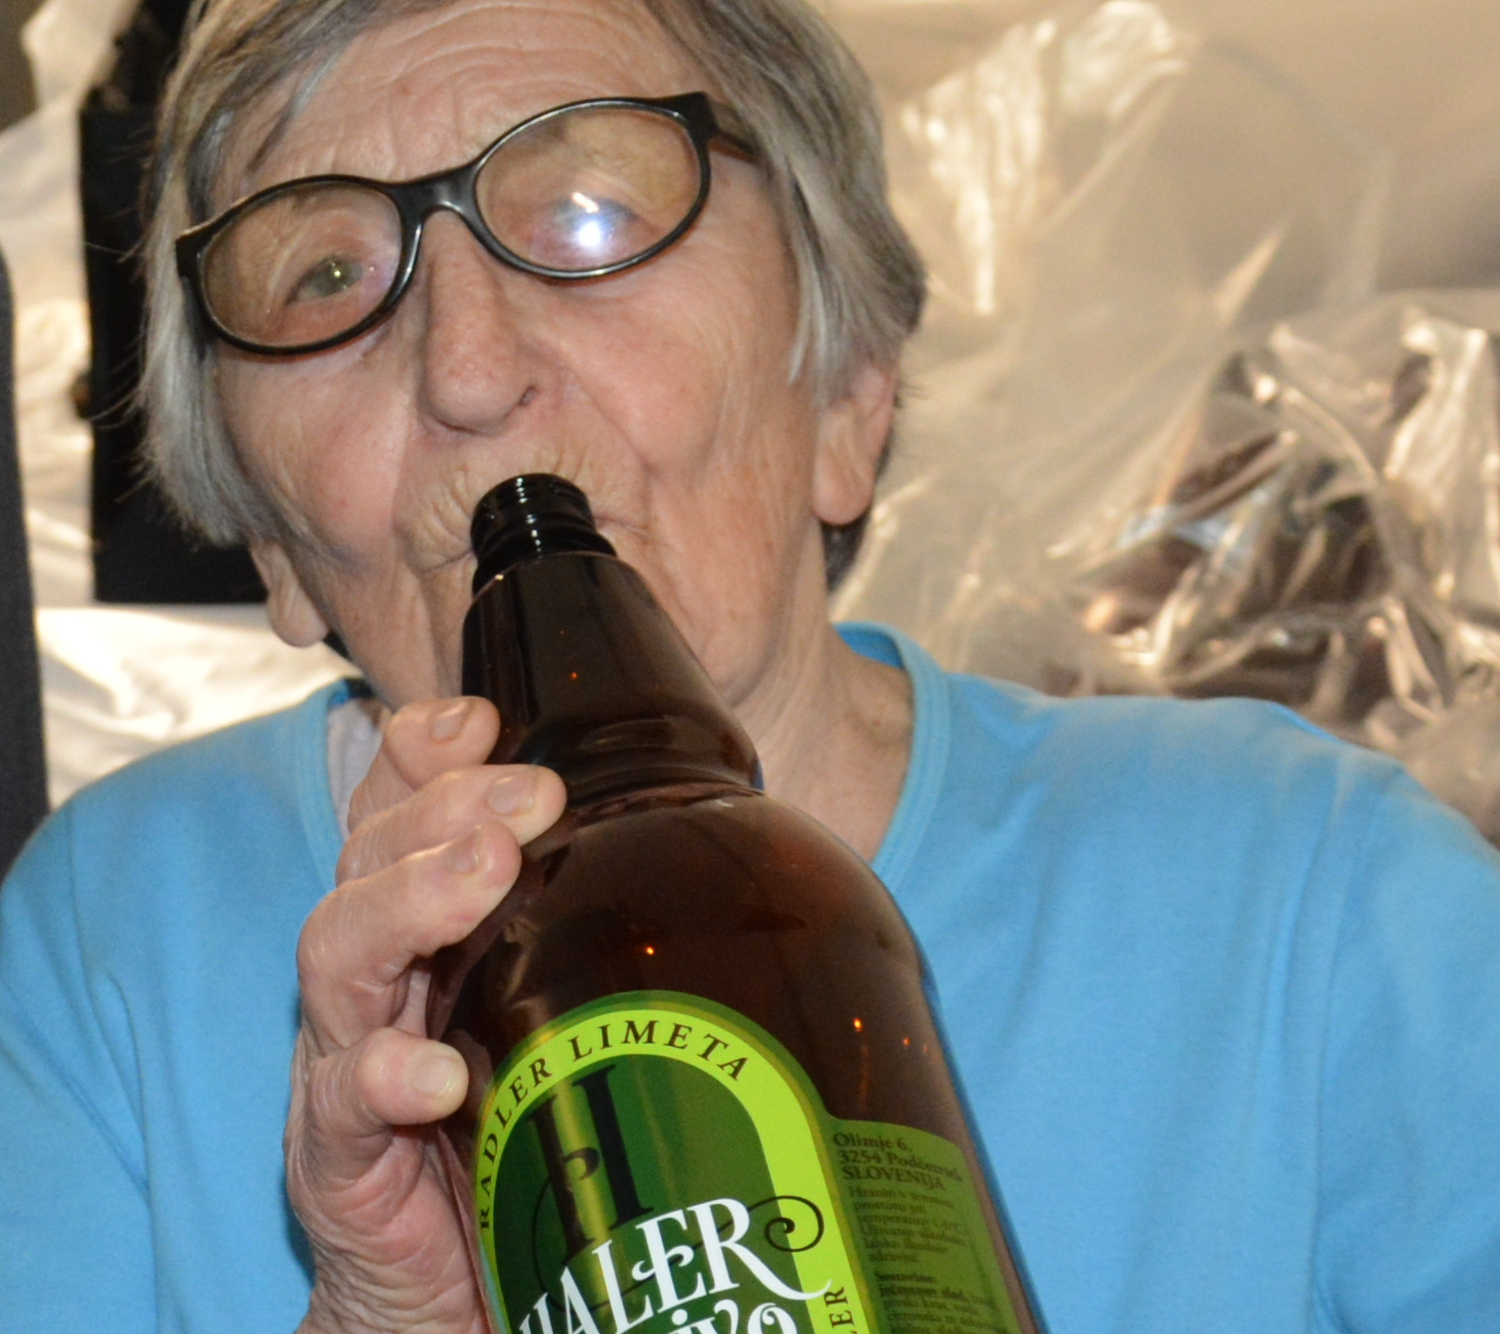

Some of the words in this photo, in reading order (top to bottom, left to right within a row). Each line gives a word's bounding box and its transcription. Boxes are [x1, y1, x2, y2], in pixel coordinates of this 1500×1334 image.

[479, 1057, 553, 1230] RADLER
[567, 1019, 749, 1082] LIMETA
[842, 1166, 946, 1191] SLOVENIJA
